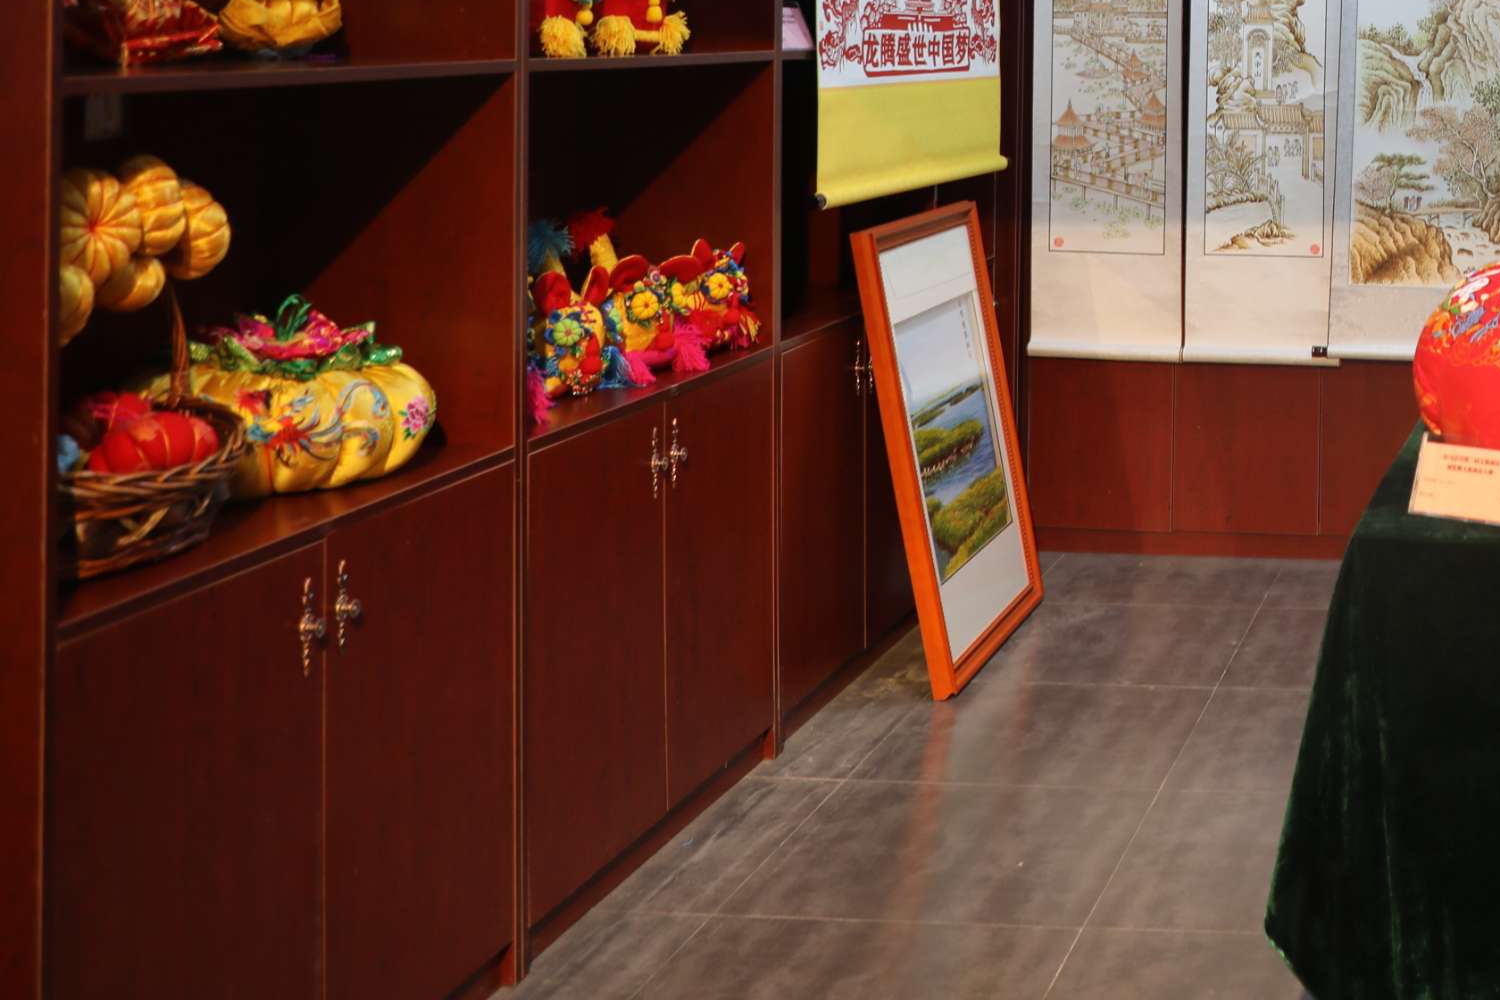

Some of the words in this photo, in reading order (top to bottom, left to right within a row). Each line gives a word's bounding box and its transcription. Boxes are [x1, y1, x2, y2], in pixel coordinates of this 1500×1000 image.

[863, 30, 970, 68] 龙腾盛世中国梦
